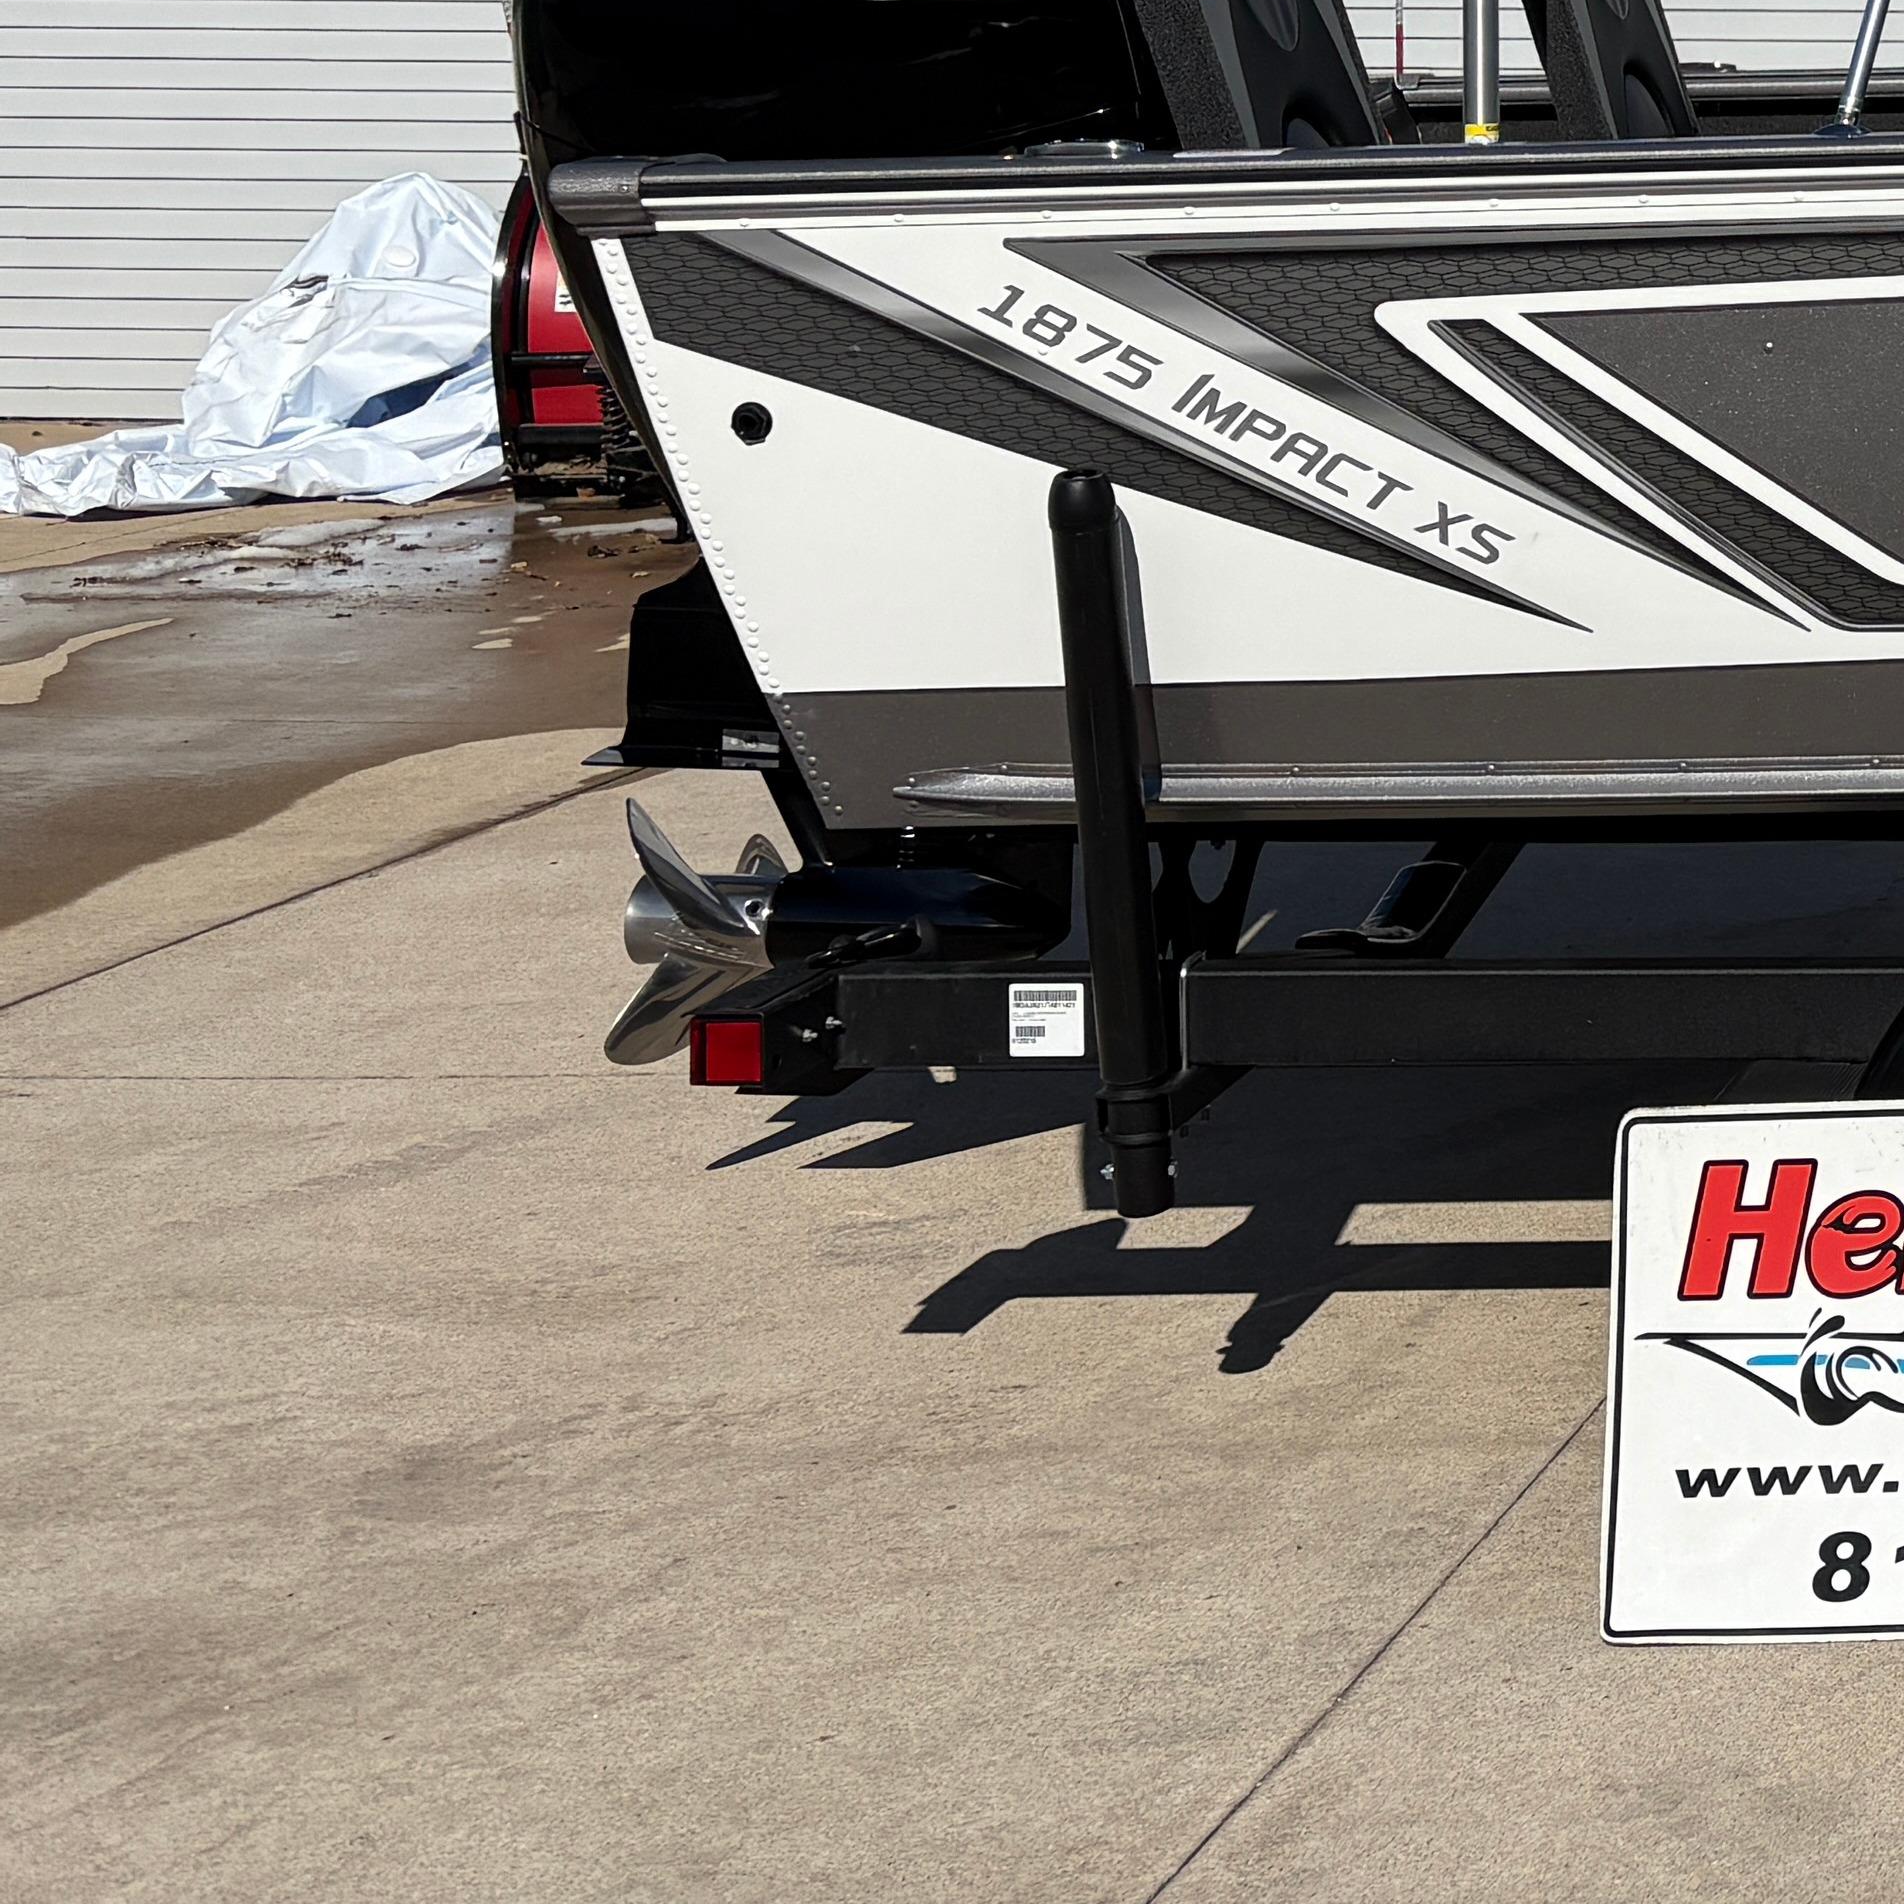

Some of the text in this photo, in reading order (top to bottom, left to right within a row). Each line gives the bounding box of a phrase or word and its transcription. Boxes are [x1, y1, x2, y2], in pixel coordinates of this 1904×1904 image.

[977, 284, 1516, 564] 1875 IMPACT XS
